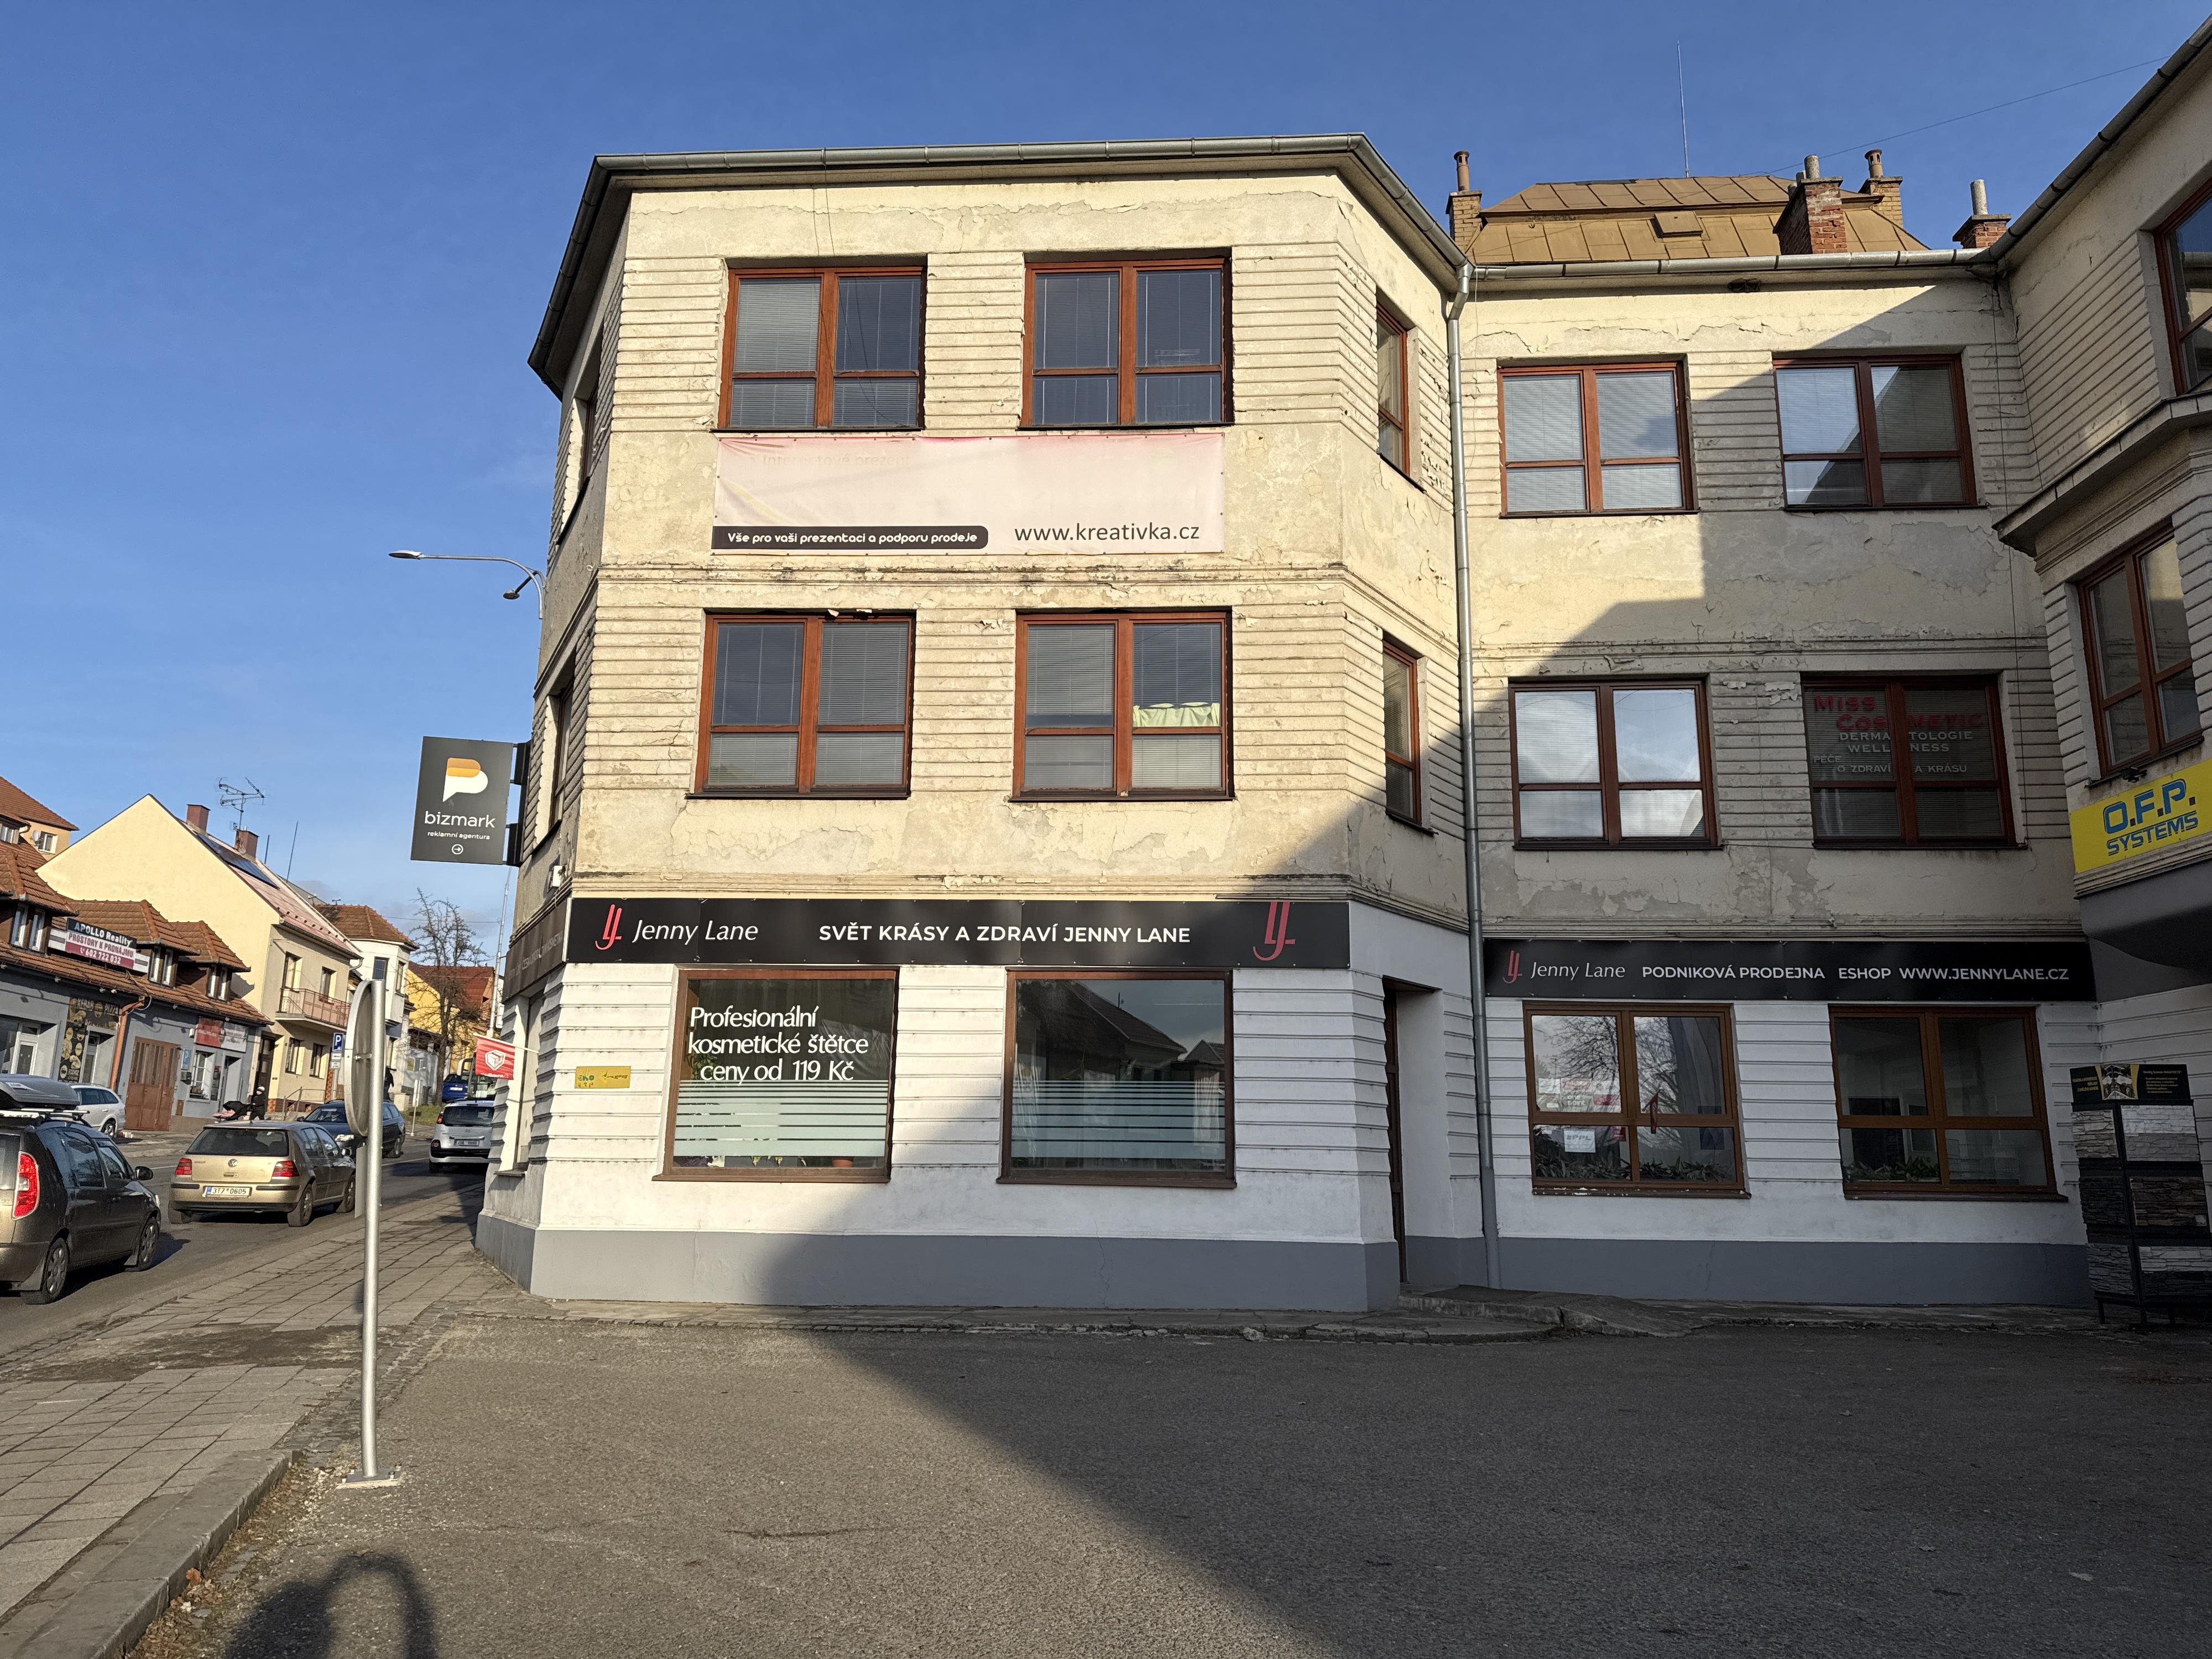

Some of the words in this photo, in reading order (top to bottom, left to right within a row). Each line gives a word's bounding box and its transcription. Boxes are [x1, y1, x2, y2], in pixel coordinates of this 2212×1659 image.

[728, 532, 750, 543] Vše
[752, 534, 772, 544] pro
[774, 532, 797, 543] vaši
[800, 533, 866, 545] prezentaci
[868, 534, 877, 543] a
[878, 533, 928, 545] podporu
[931, 532, 978, 544] prodeje
[1014, 522, 1200, 541] www.kreativka.cz
[1851, 763, 1891, 773] ZDRAVÍ
[1928, 763, 1968, 773] KRÁSU
[2103, 779, 2196, 834] O.F.P.
[424, 810, 496, 828] bizmark
[2106, 810, 2199, 856] SYSTEMS
[68, 932, 98, 949] PROSTORY
[99, 941, 104, 950] K
[74, 922, 105, 938] APOLLO
[106, 931, 132, 948] Reality
[632, 919, 699, 945] Jenny
[705, 920, 759, 941] Lane
[818, 922, 872, 941] SVĚT
[879, 922, 950, 941] KRÁSY
[954, 926, 971, 941] A
[977, 924, 1057, 942] ZDRAVÍ
[1063, 927, 1132, 942] JENNY
[1137, 927, 1191, 943] LANE
[85, 947, 97, 958] 602
[97, 952, 109, 963] 722
[110, 954, 122, 965] 032
[1530, 961, 1579, 981] Jenny
[1585, 962, 1626, 978] Lane
[1642, 965, 1736, 979] PODNIKOVÁ
[1740, 967, 1825, 980] PRODEJNA
[1838, 968, 1891, 980] ESHOP
[1899, 968, 2069, 980] WWW.JENNYLANE.CZ
[690, 1005, 820, 1028] Profesionální
[335, 1035, 342, 1046] P
[688, 1031, 801, 1054] kosmetické
[807, 1034, 869, 1054] štětce
[700, 1065, 749, 1087] ceny
[754, 1058, 783, 1081] od
[792, 1060, 821, 1081] 119
[829, 1060, 854, 1081] Kč
